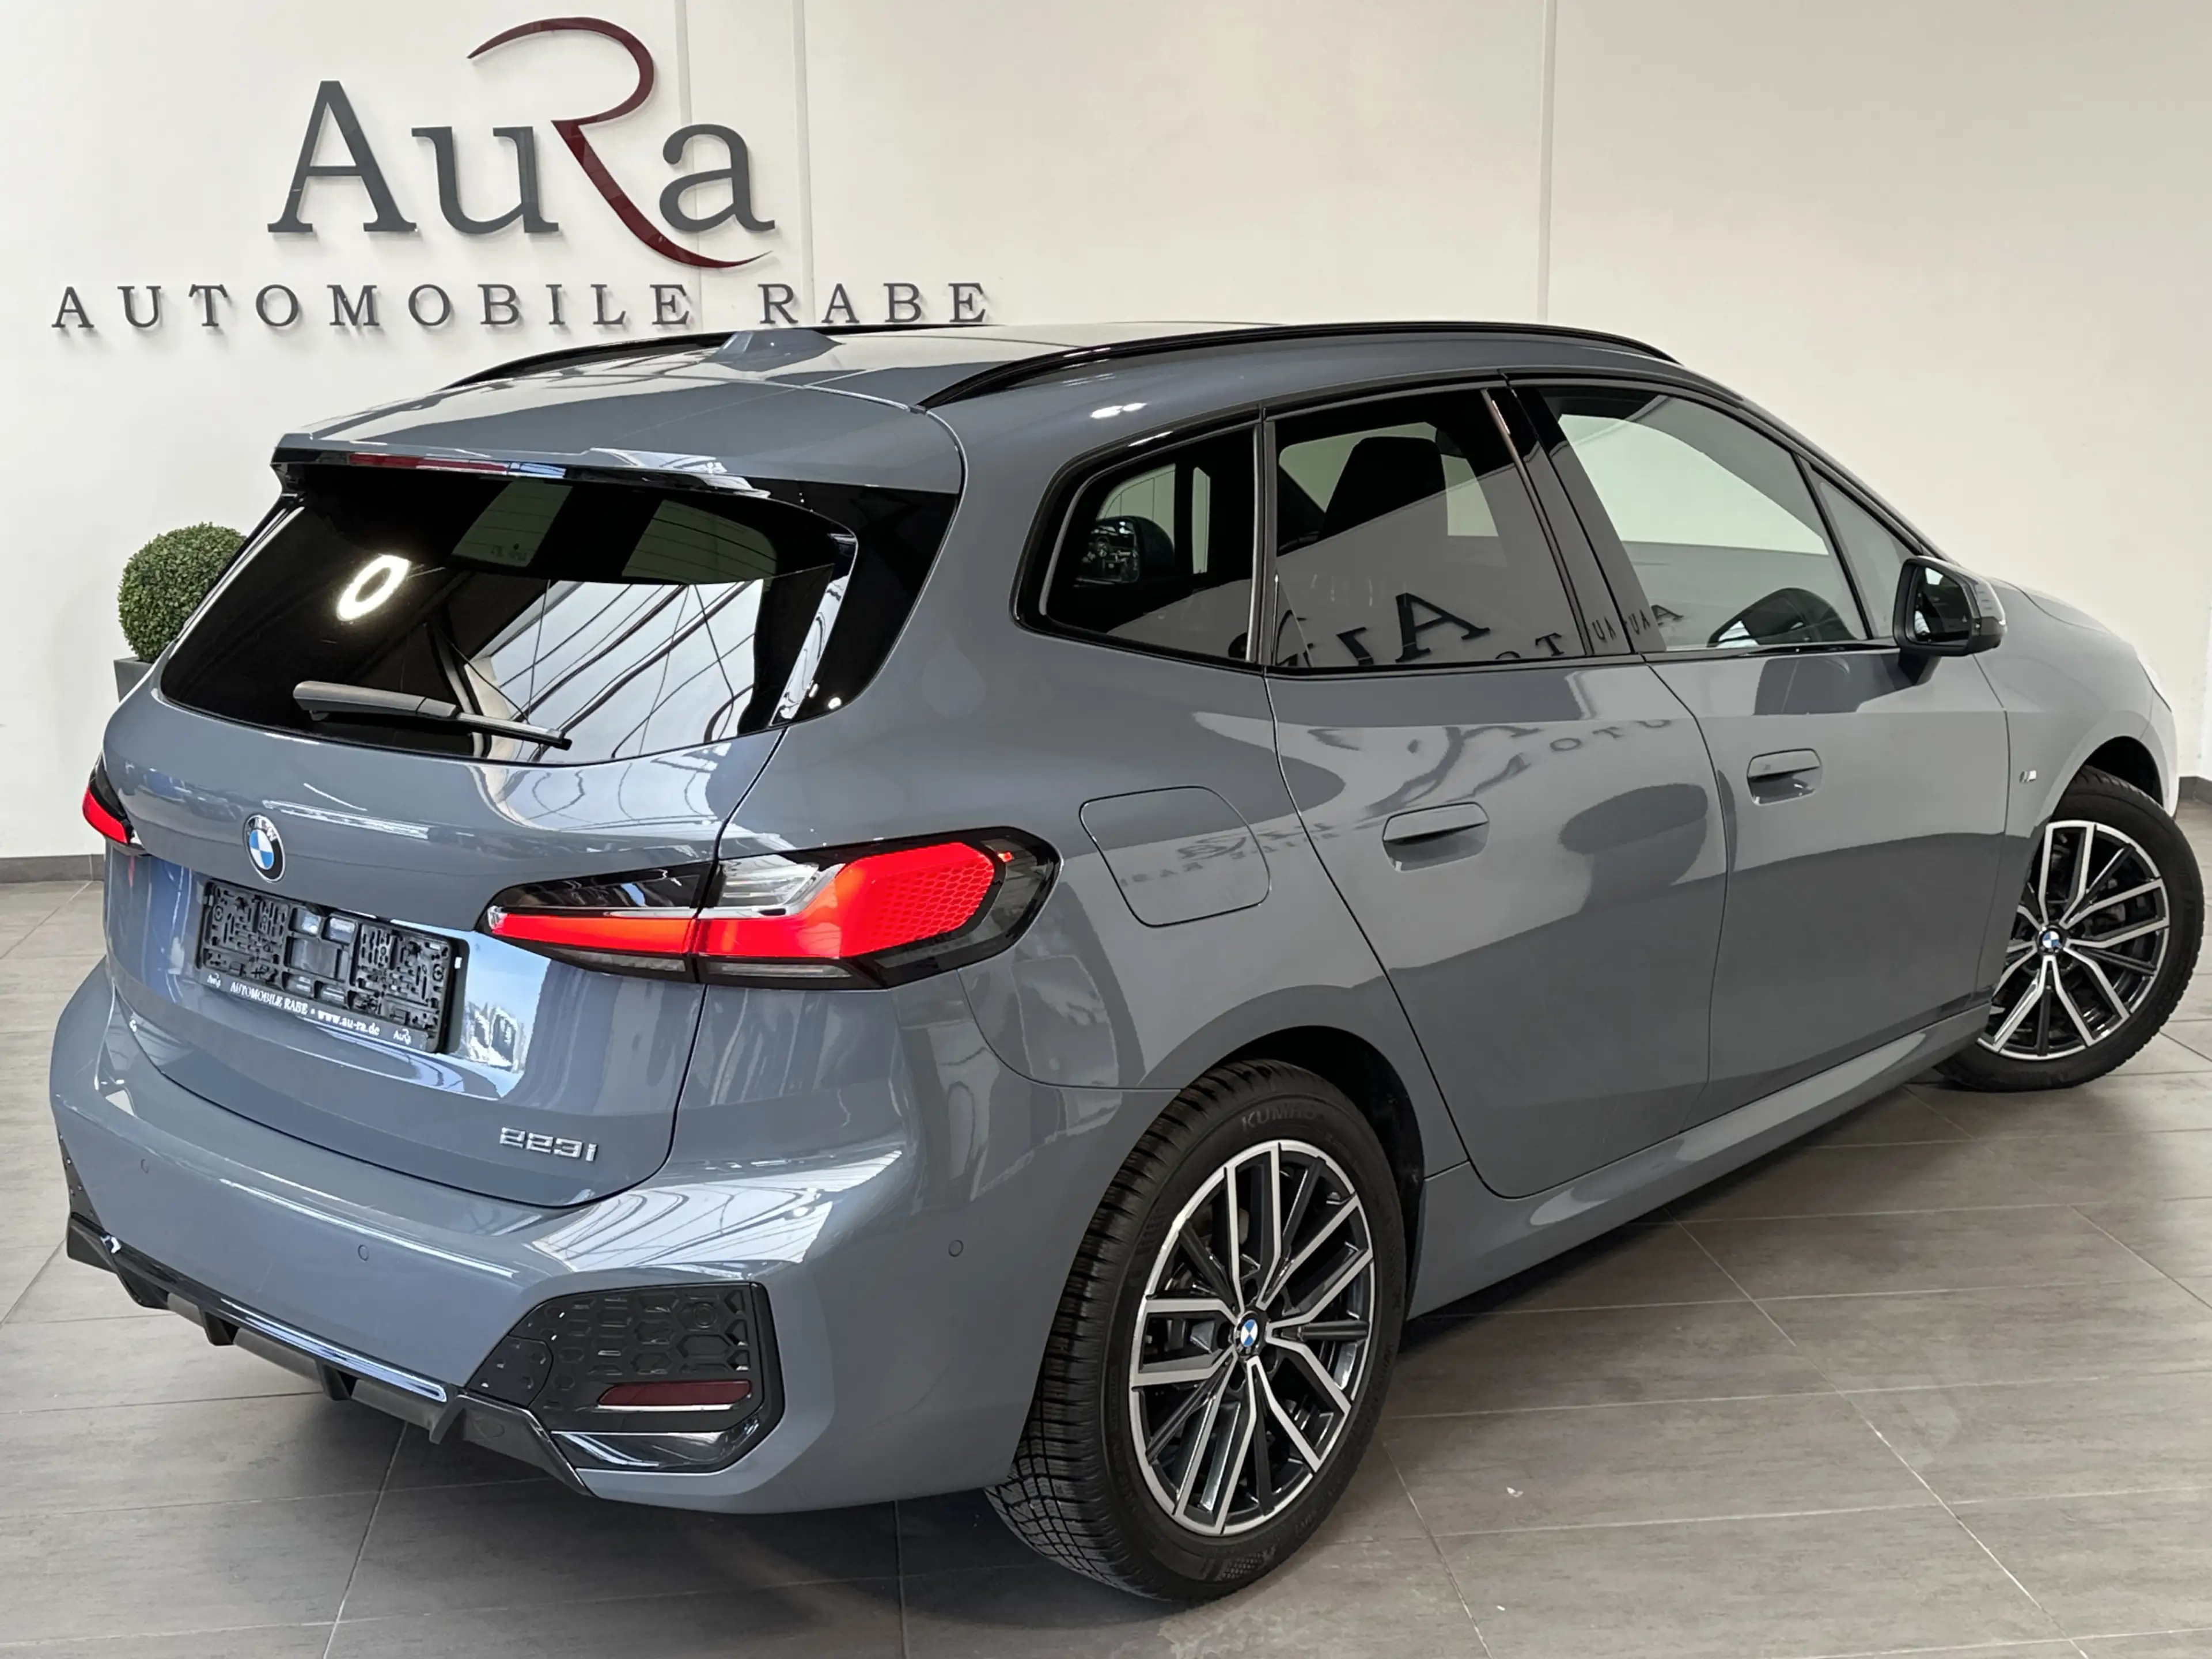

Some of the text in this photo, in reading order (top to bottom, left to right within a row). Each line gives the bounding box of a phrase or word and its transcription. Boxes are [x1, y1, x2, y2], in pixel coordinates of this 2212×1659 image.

[268, 17, 775, 269] AuRa
[51, 282, 986, 329] AUTOMOBILE RABE
[230, 982, 282, 1009] AUTOMOBILE
[284, 997, 309, 1015] RABE
[317, 1009, 381, 1036] www.au-ra.de
[499, 1127, 597, 1162] 223i
